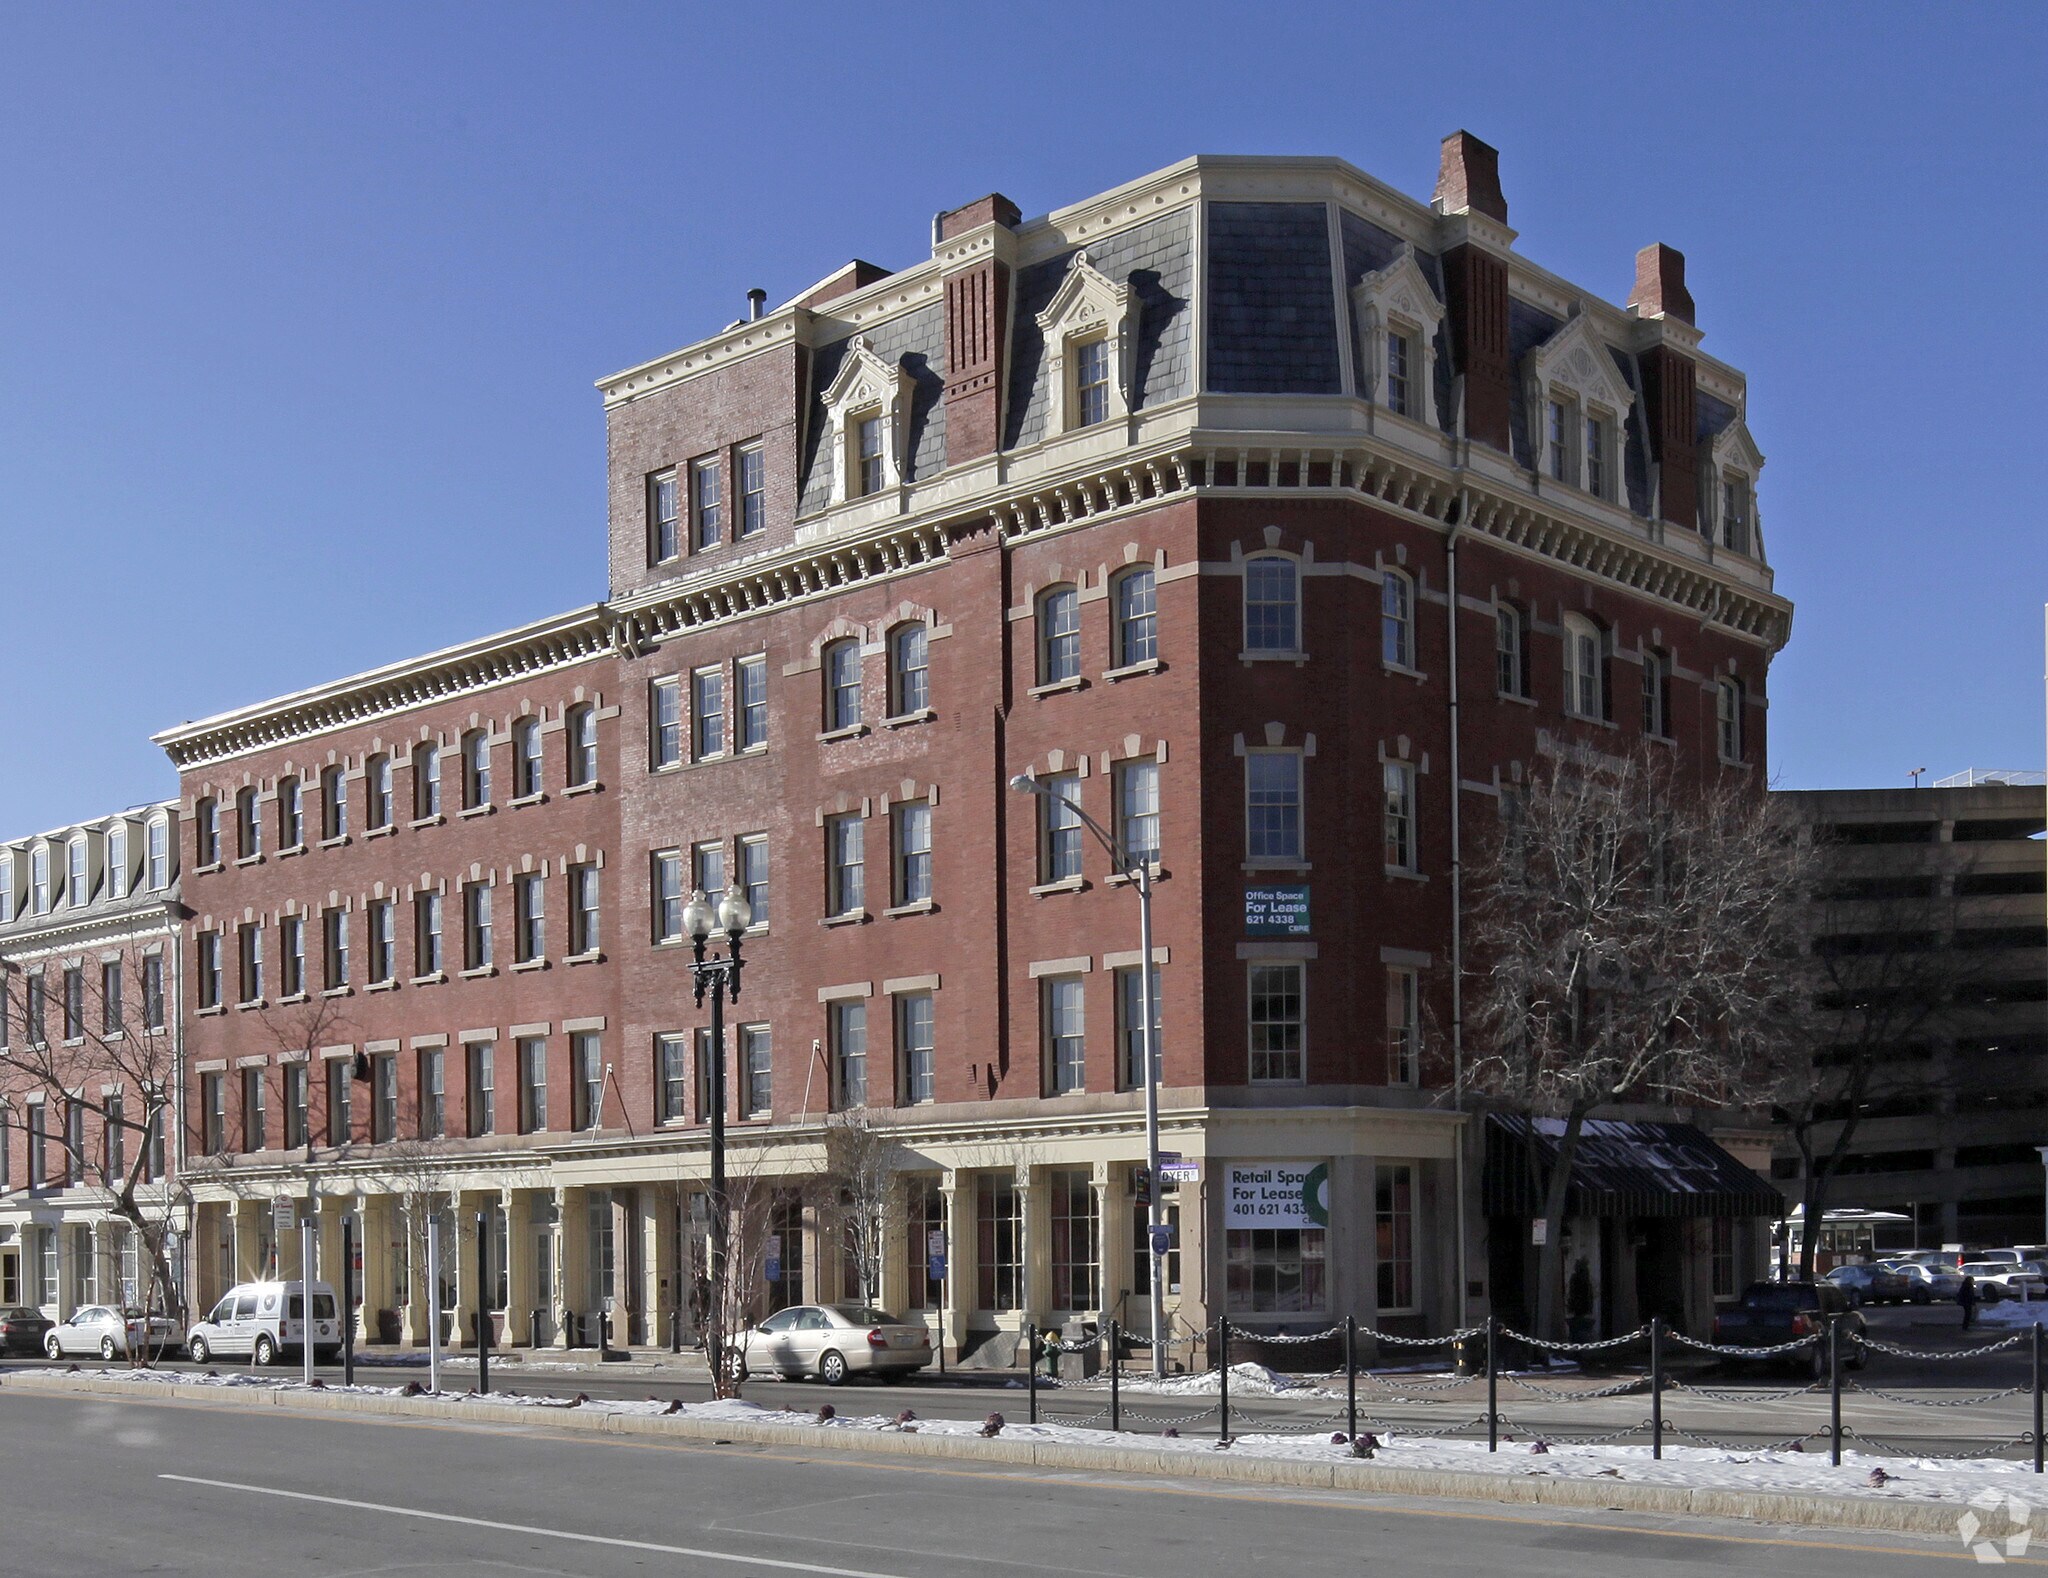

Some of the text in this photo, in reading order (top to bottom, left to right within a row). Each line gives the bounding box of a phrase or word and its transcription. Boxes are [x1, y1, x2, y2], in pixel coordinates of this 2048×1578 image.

[1246, 891, 1304, 901] Office Space
[1246, 902, 1307, 913] For Lease
[1246, 915, 1295, 924] 621 4338
[1162, 1171, 1190, 1182] DYER
[1232, 1170, 1272, 1183] Retail
[1232, 1187, 1303, 1199] For Lease
[1233, 1204, 1254, 1215] 401
[1258, 1204, 1279, 1215] 621
